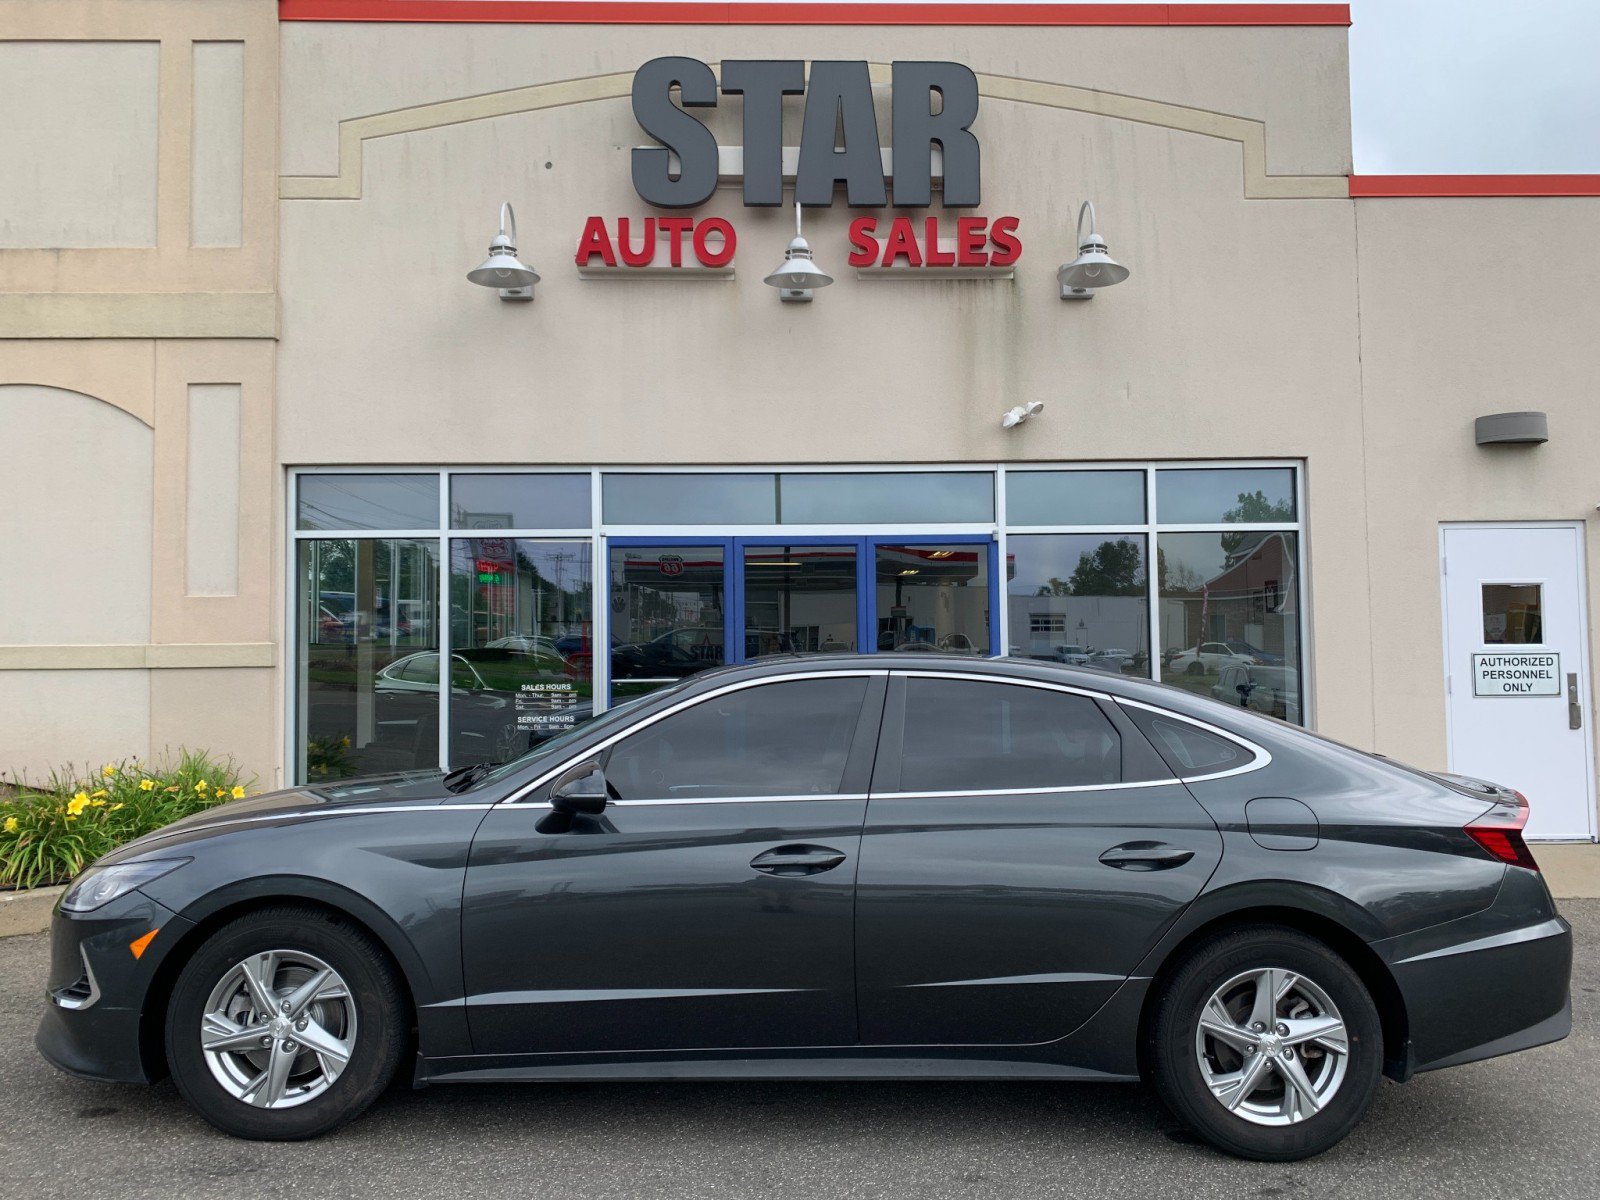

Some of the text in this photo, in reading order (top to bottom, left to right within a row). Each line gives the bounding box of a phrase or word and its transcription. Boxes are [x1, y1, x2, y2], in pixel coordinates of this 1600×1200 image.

[631, 56, 981, 209] STAR
[575, 216, 1023, 268] AUTO SALES
[689, 645, 723, 660] STAR
[1480, 657, 1554, 667] AUTHORIZED
[1482, 670, 1553, 680] PERSONNEL
[1503, 683, 1533, 692] ONLY
